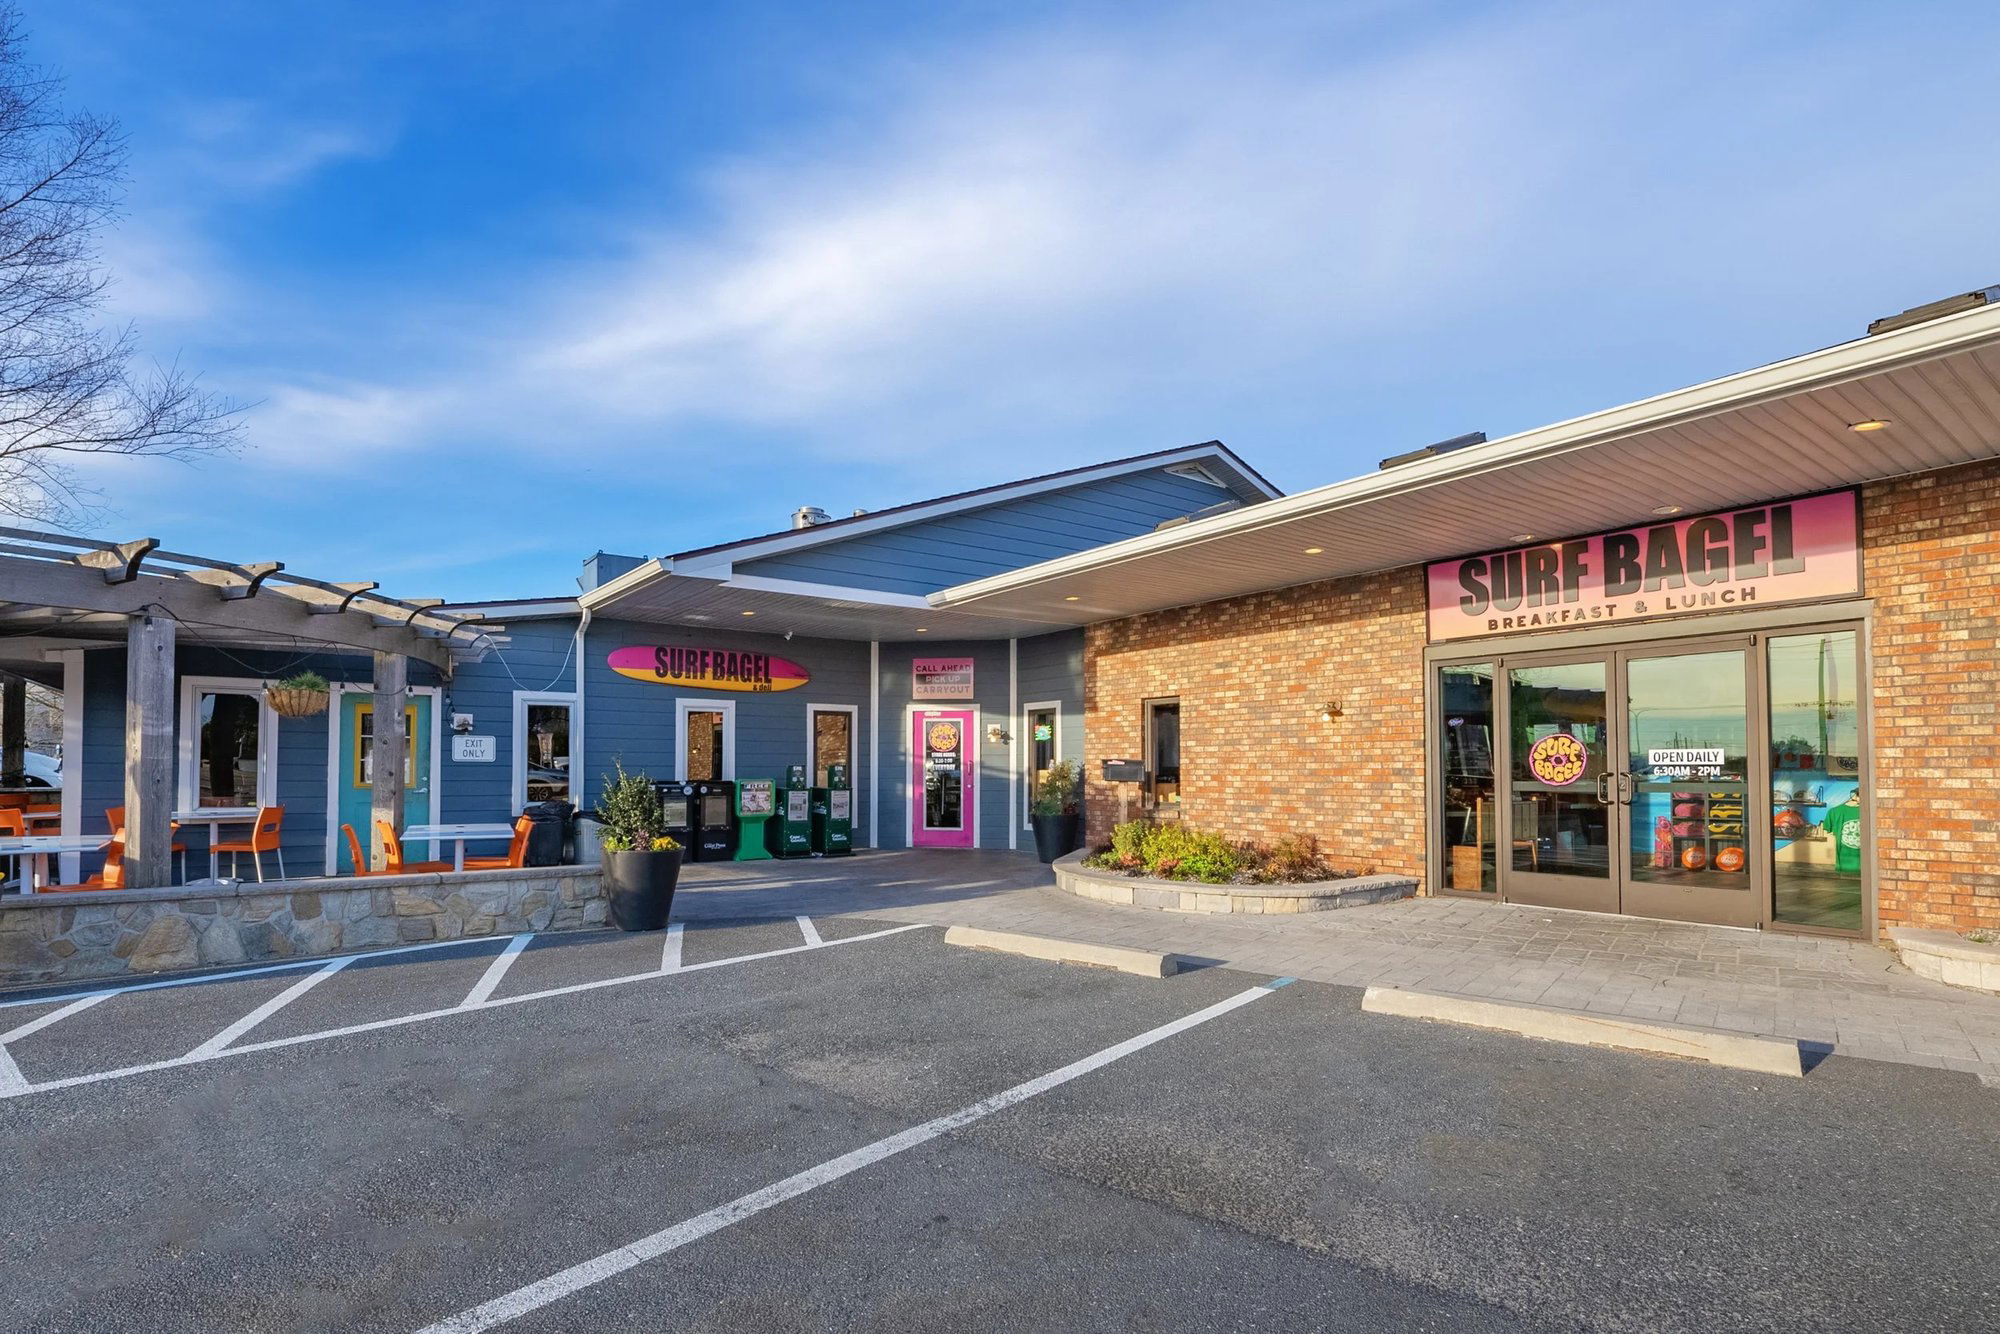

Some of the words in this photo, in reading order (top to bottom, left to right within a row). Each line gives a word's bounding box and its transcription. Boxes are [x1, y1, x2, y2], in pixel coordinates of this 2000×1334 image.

[1459, 540, 1589, 617] SURF
[1603, 504, 1806, 598] BAGEL
[1488, 603, 1618, 631] BREAKFAST
[1633, 600, 1648, 614] &
[1666, 586, 1757, 610] LUNCH
[655, 646, 710, 679] SURF
[712, 650, 773, 684] BAGEL
[940, 664, 971, 672] AHEAD
[925, 675, 946, 683] PICK
[916, 686, 970, 694] CARRYOUT
[465, 739, 483, 748] EXIT
[462, 749, 485, 758] ONLY
[1533, 737, 1581, 762] SURF
[1653, 751, 1684, 762] OPEN
[1686, 751, 1720, 762] DAILY
[1534, 760, 1582, 783] BAGEL
[1653, 766, 1691, 776] 6:30AM
[1697, 766, 1721, 776] 2PM
